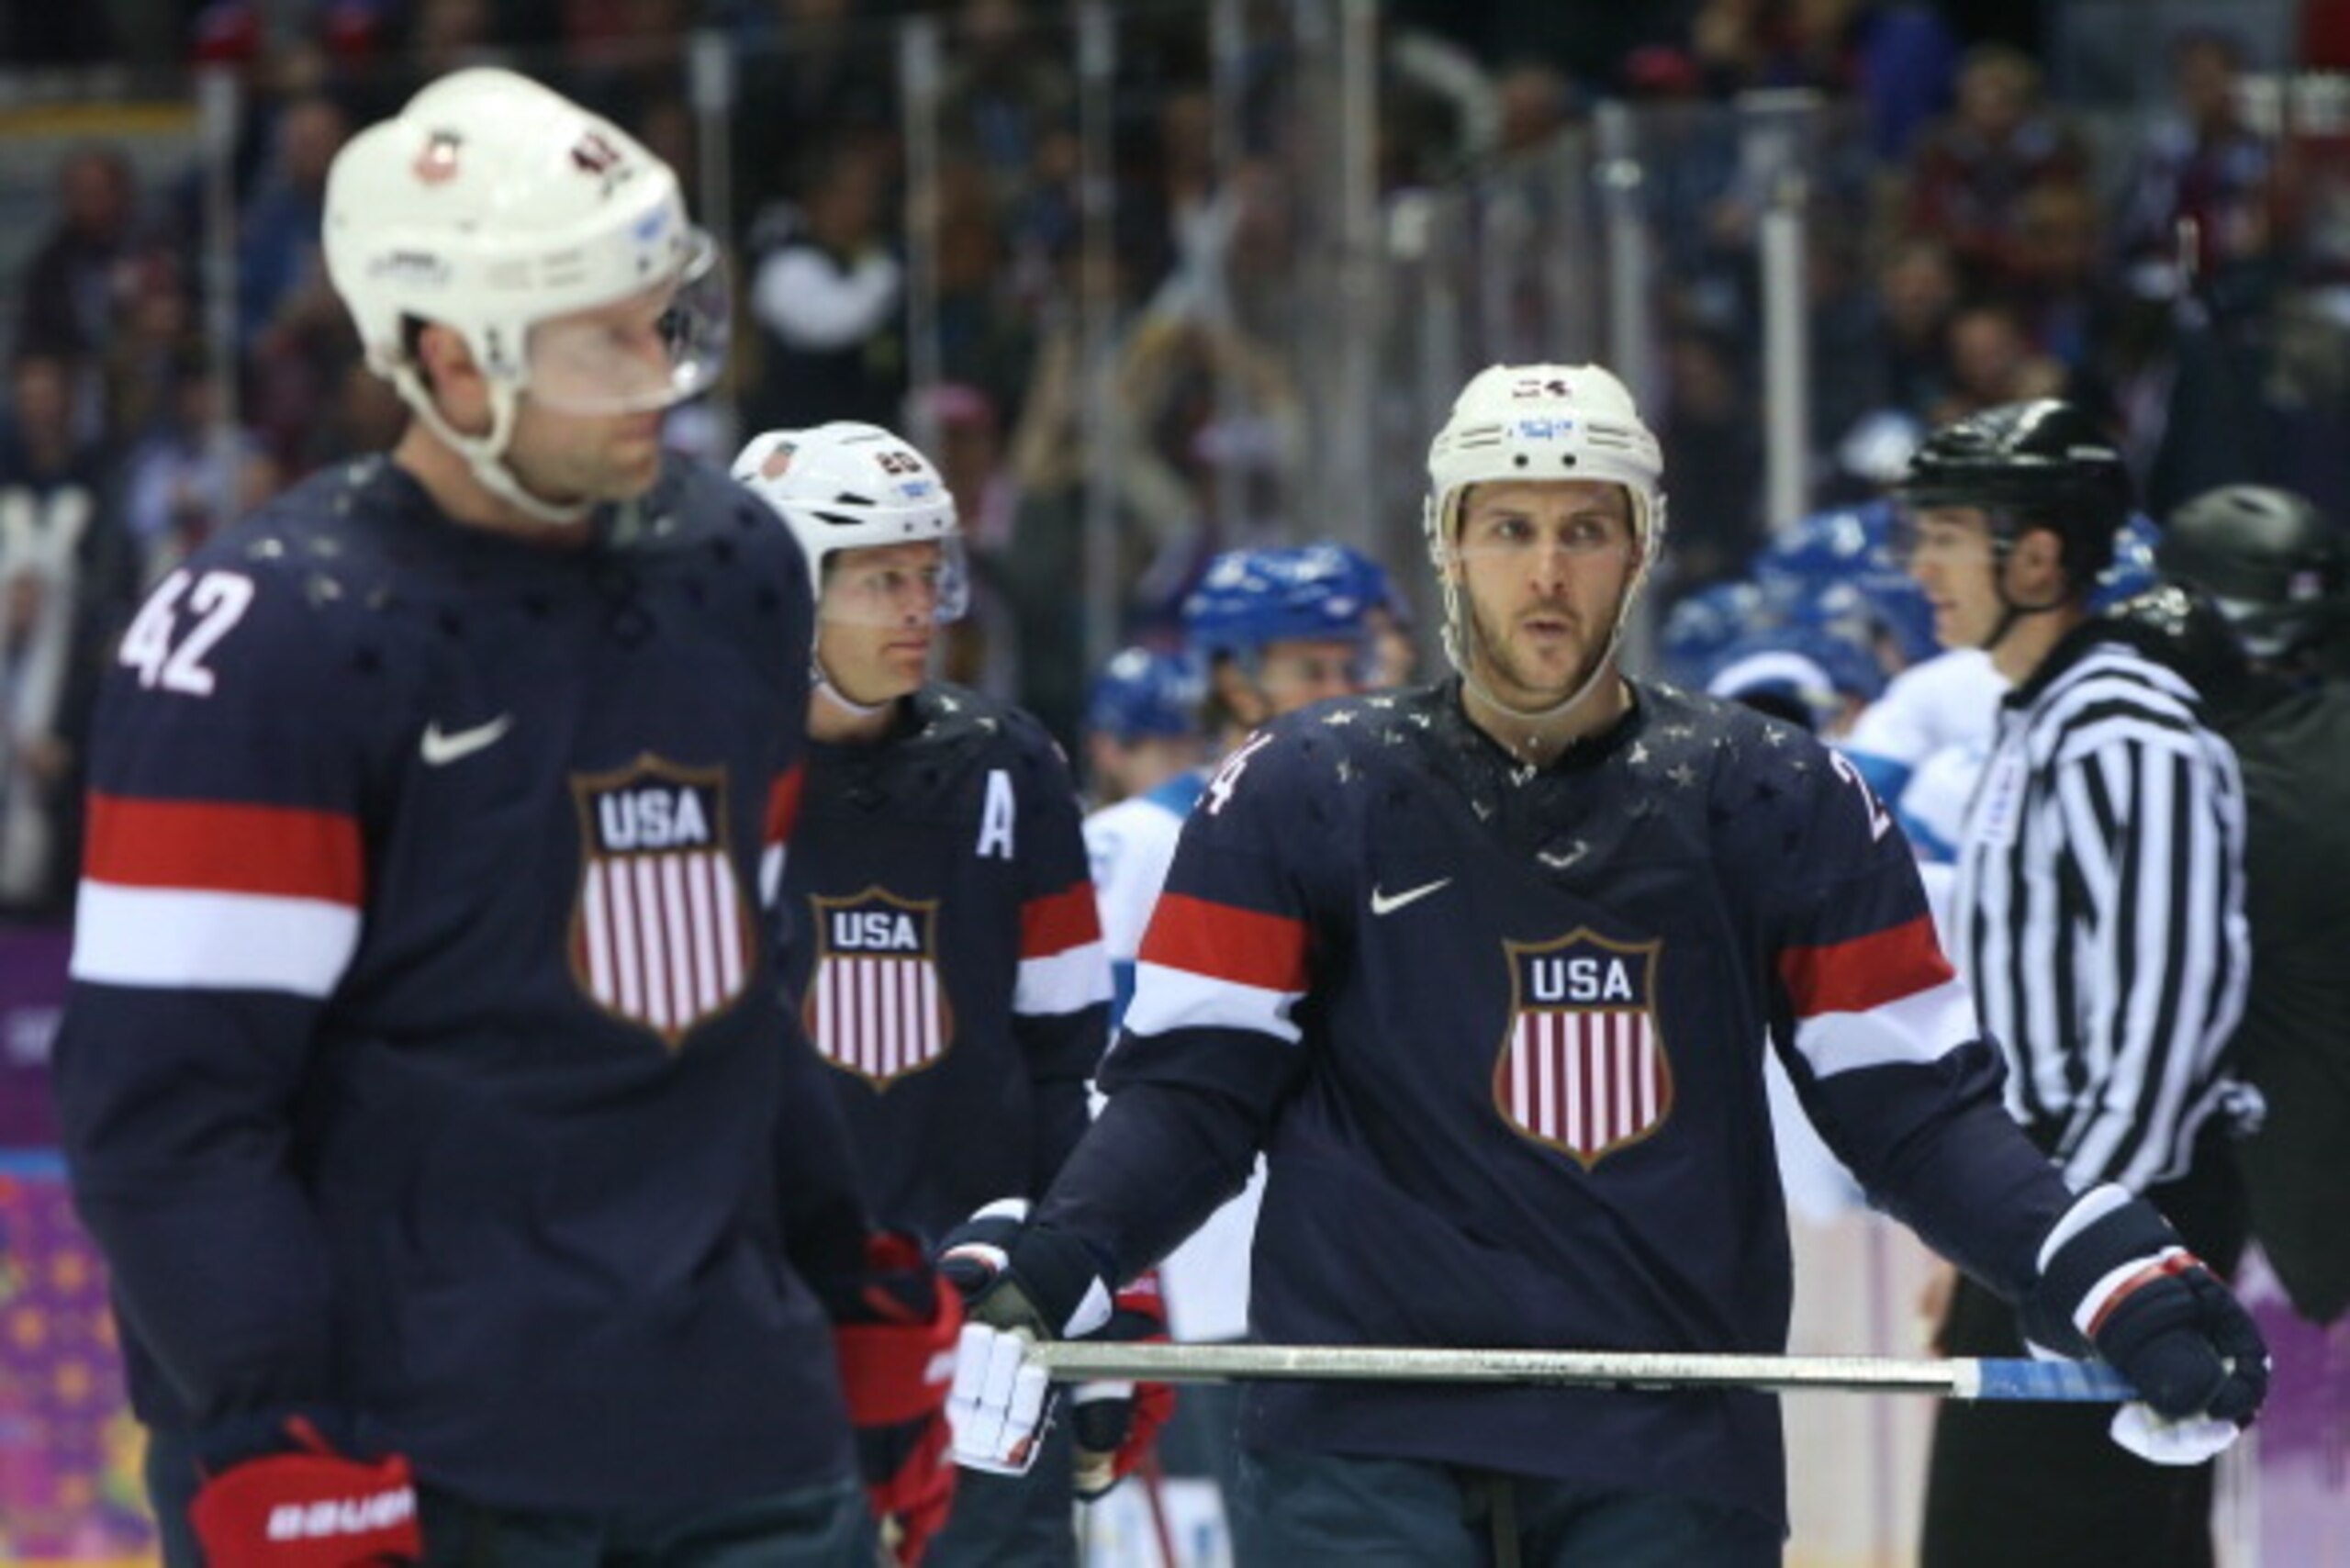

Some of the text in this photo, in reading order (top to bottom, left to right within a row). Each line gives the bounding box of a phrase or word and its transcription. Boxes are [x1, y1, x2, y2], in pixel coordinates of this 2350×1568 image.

[118, 567, 256, 698] 42
[975, 768, 1017, 860] A
[1193, 729, 1274, 816] 4
[1829, 748, 1893, 844] 2
[599, 786, 710, 851] USA
[833, 911, 919, 950] USA
[1532, 958, 1633, 1002] USA
